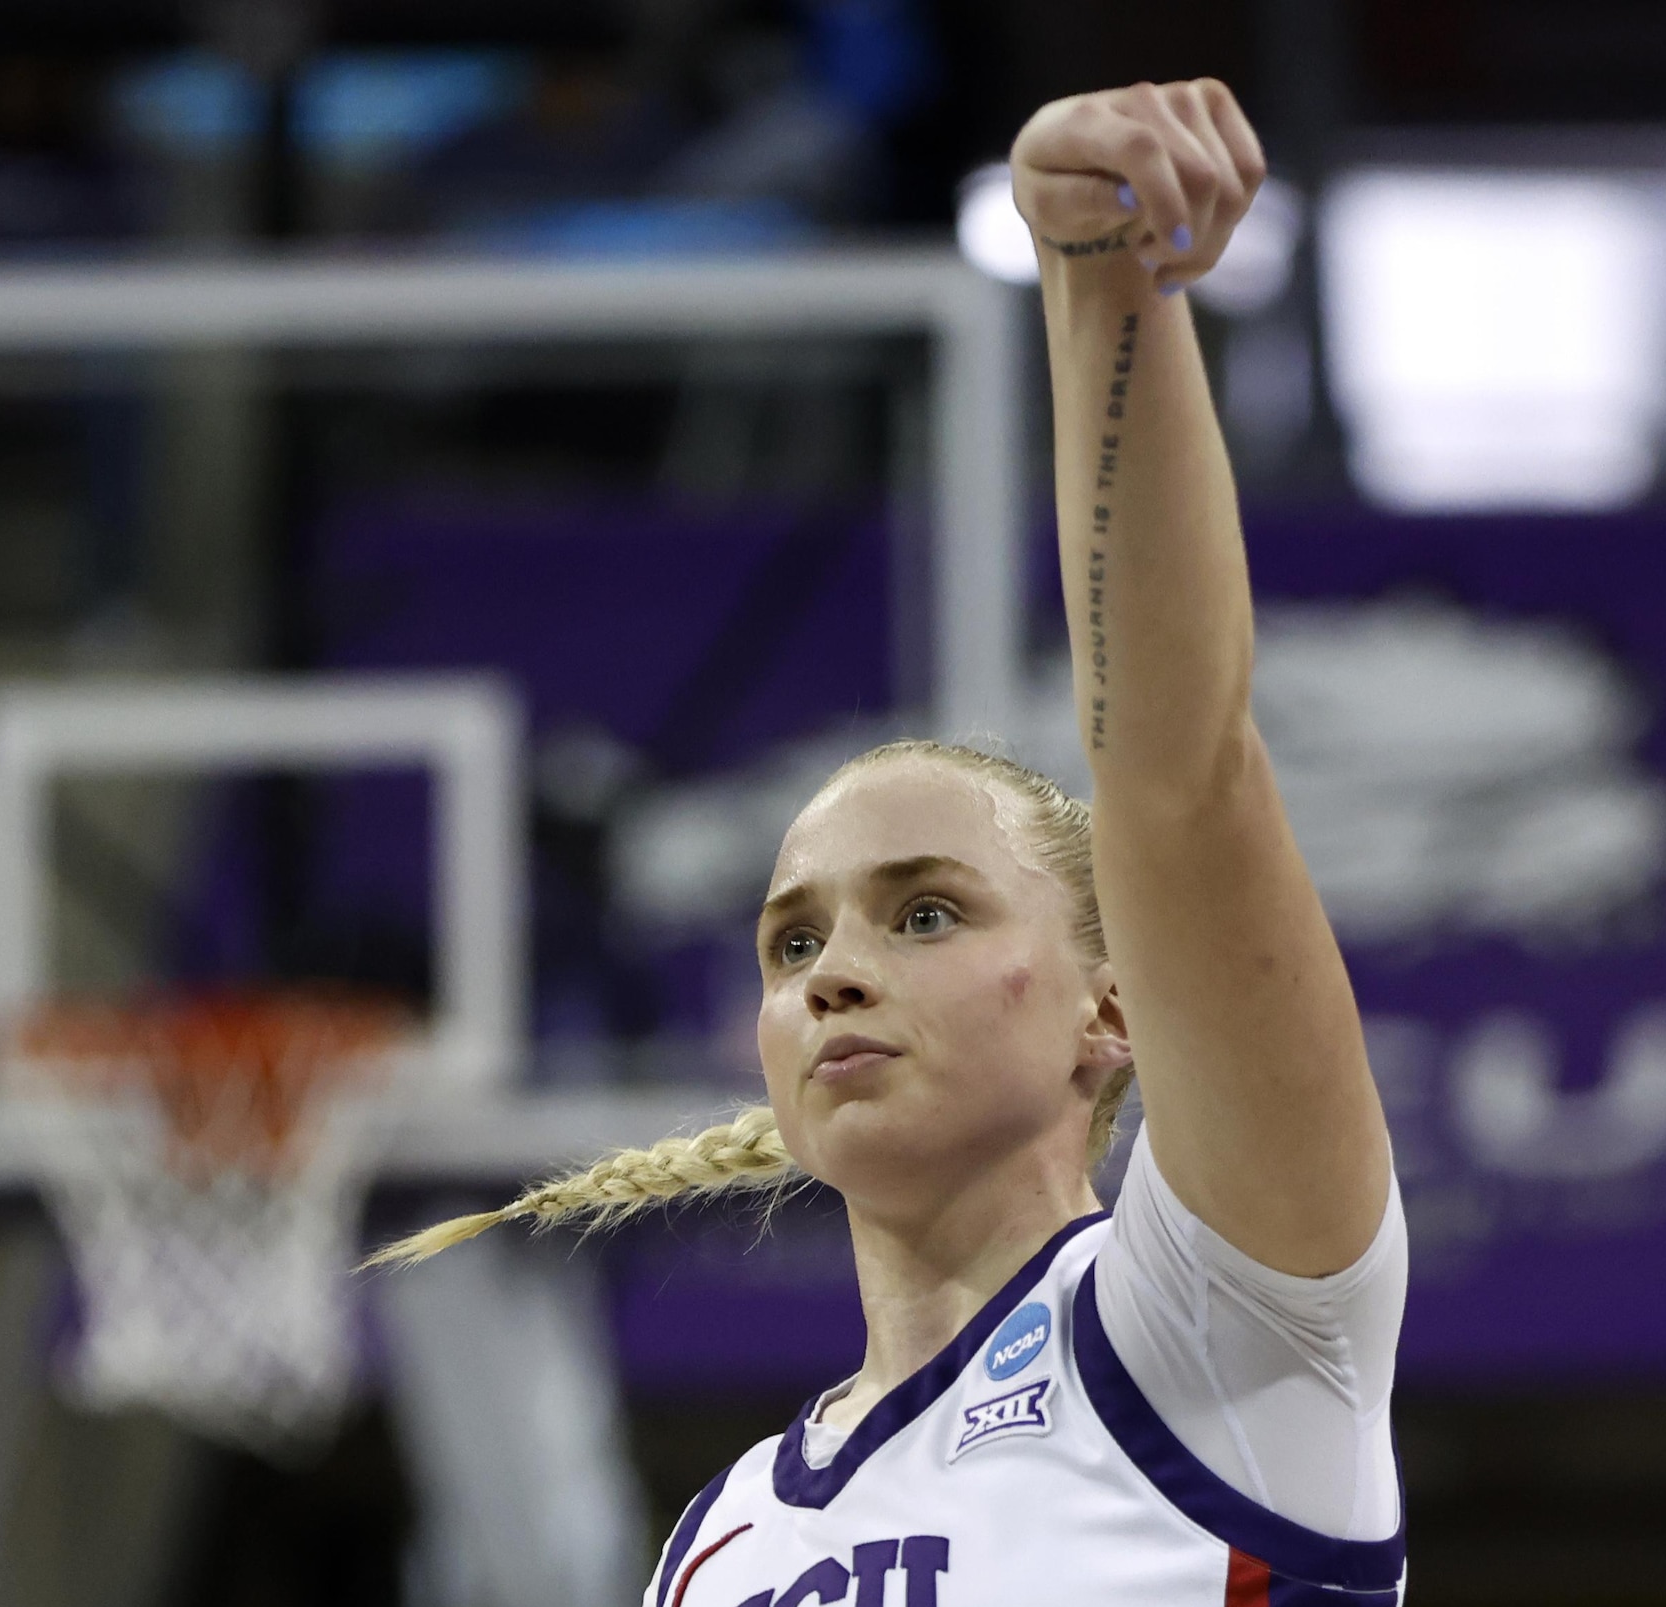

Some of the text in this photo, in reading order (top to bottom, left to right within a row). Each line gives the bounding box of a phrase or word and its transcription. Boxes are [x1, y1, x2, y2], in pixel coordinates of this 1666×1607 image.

[1089, 312, 1140, 750] THE JOURNEY IS THE DREAM
[992, 1324, 1046, 1370] NCAA
